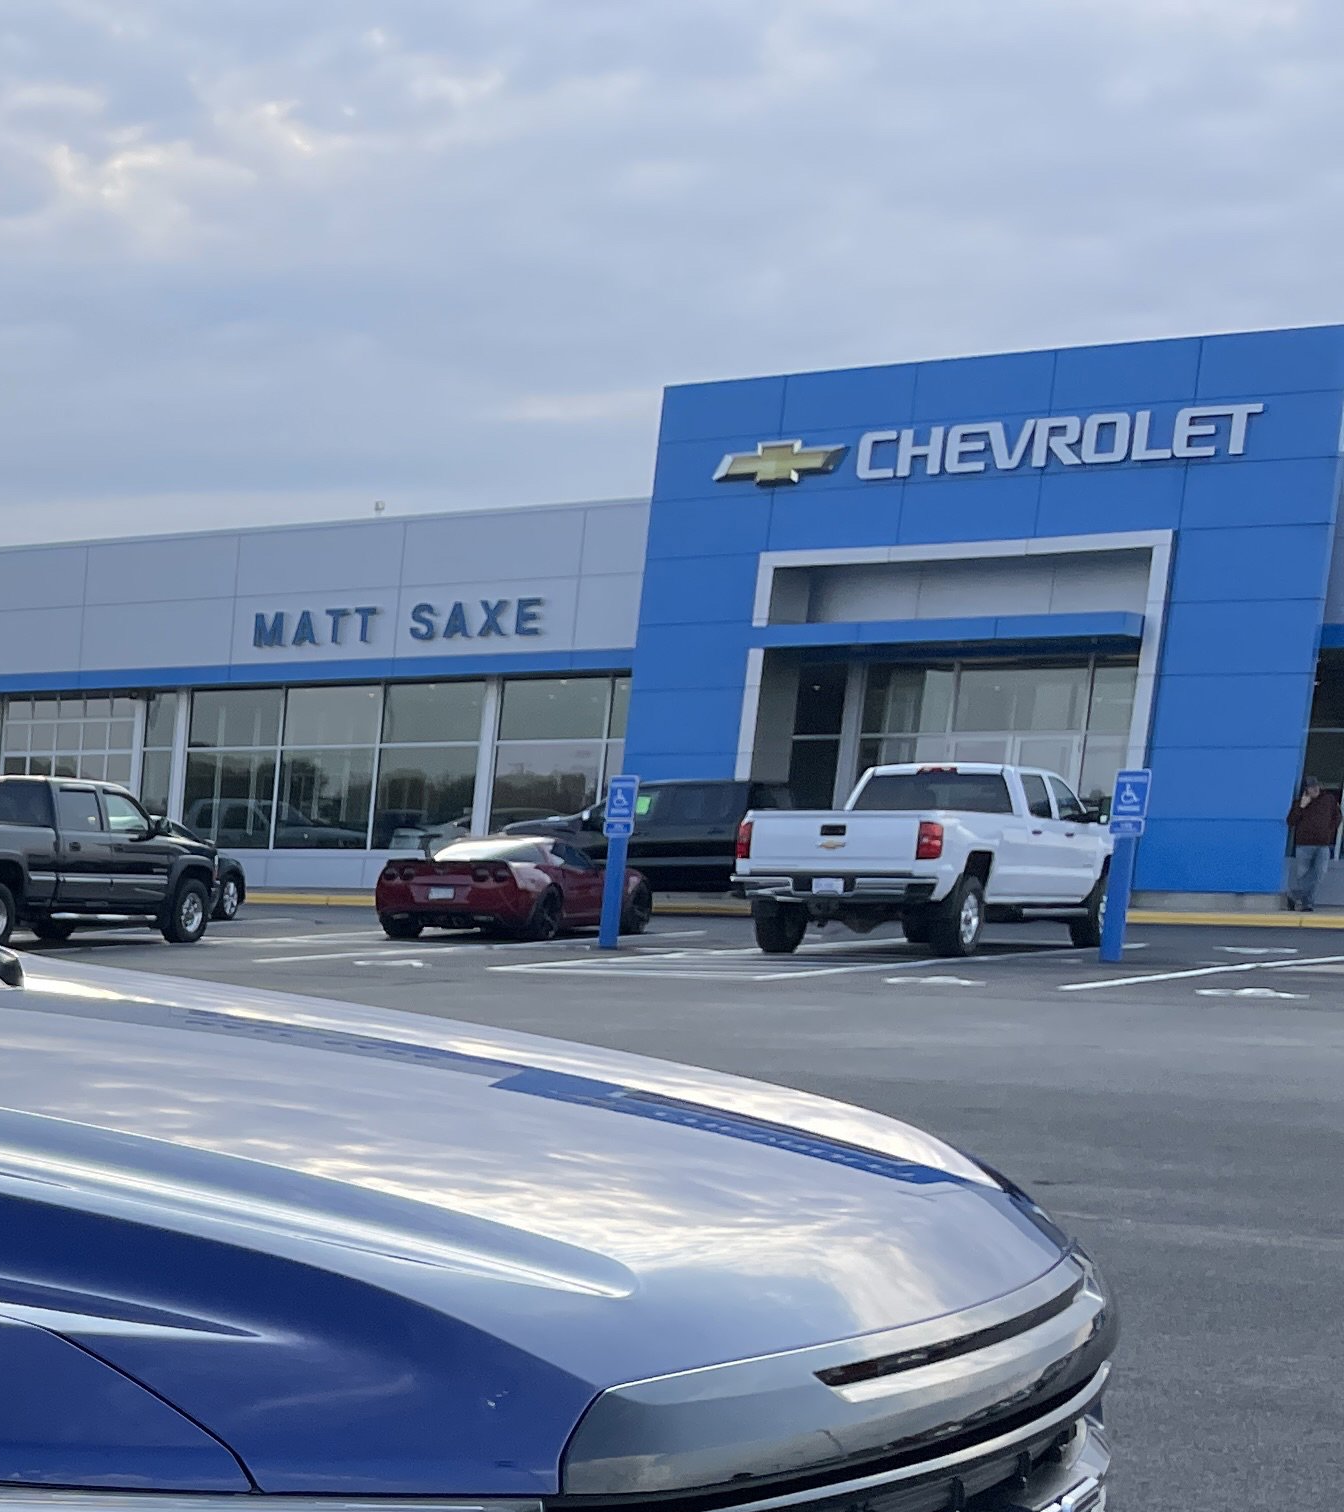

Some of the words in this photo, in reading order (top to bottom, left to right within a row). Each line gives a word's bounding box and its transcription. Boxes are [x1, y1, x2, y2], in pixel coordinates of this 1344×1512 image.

[856, 402, 1265, 482] CHEVROLET
[253, 606, 380, 649] MATT
[408, 597, 545, 641] SAXE
